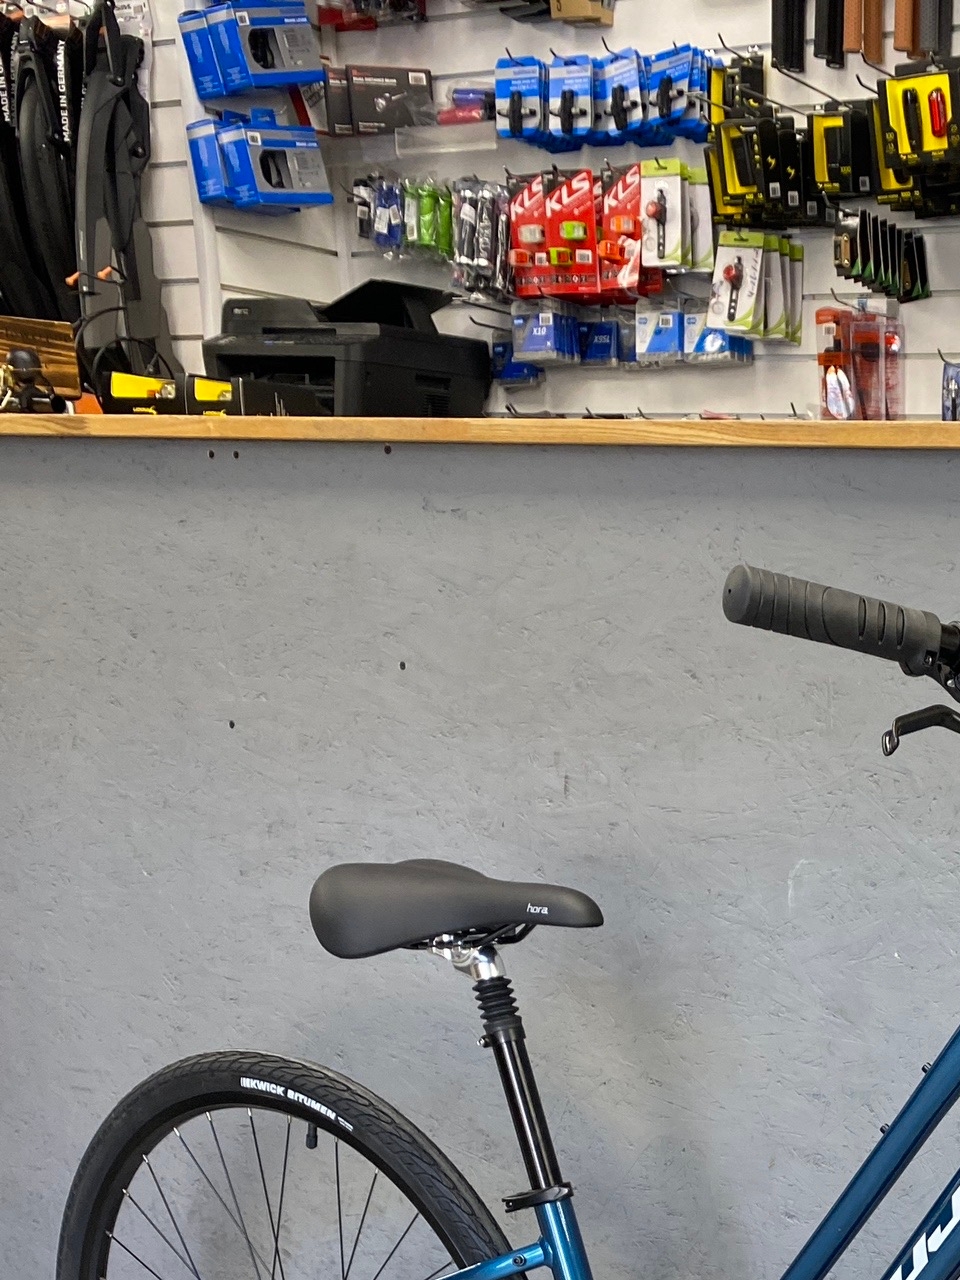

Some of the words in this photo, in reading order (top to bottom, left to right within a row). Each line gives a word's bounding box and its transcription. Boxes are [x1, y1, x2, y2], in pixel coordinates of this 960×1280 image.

[57, 40, 66, 93] GERMANY
[0, 86, 11, 122] MADE
[58, 95, 67, 107] IN
[60, 110, 71, 142] MADE
[545, 171, 590, 218] KLS
[603, 165, 640, 215] KLS
[526, 902, 549, 914] hora
[248, 1078, 286, 1097] KWICK
[286, 1089, 337, 1121] BITUMEN
